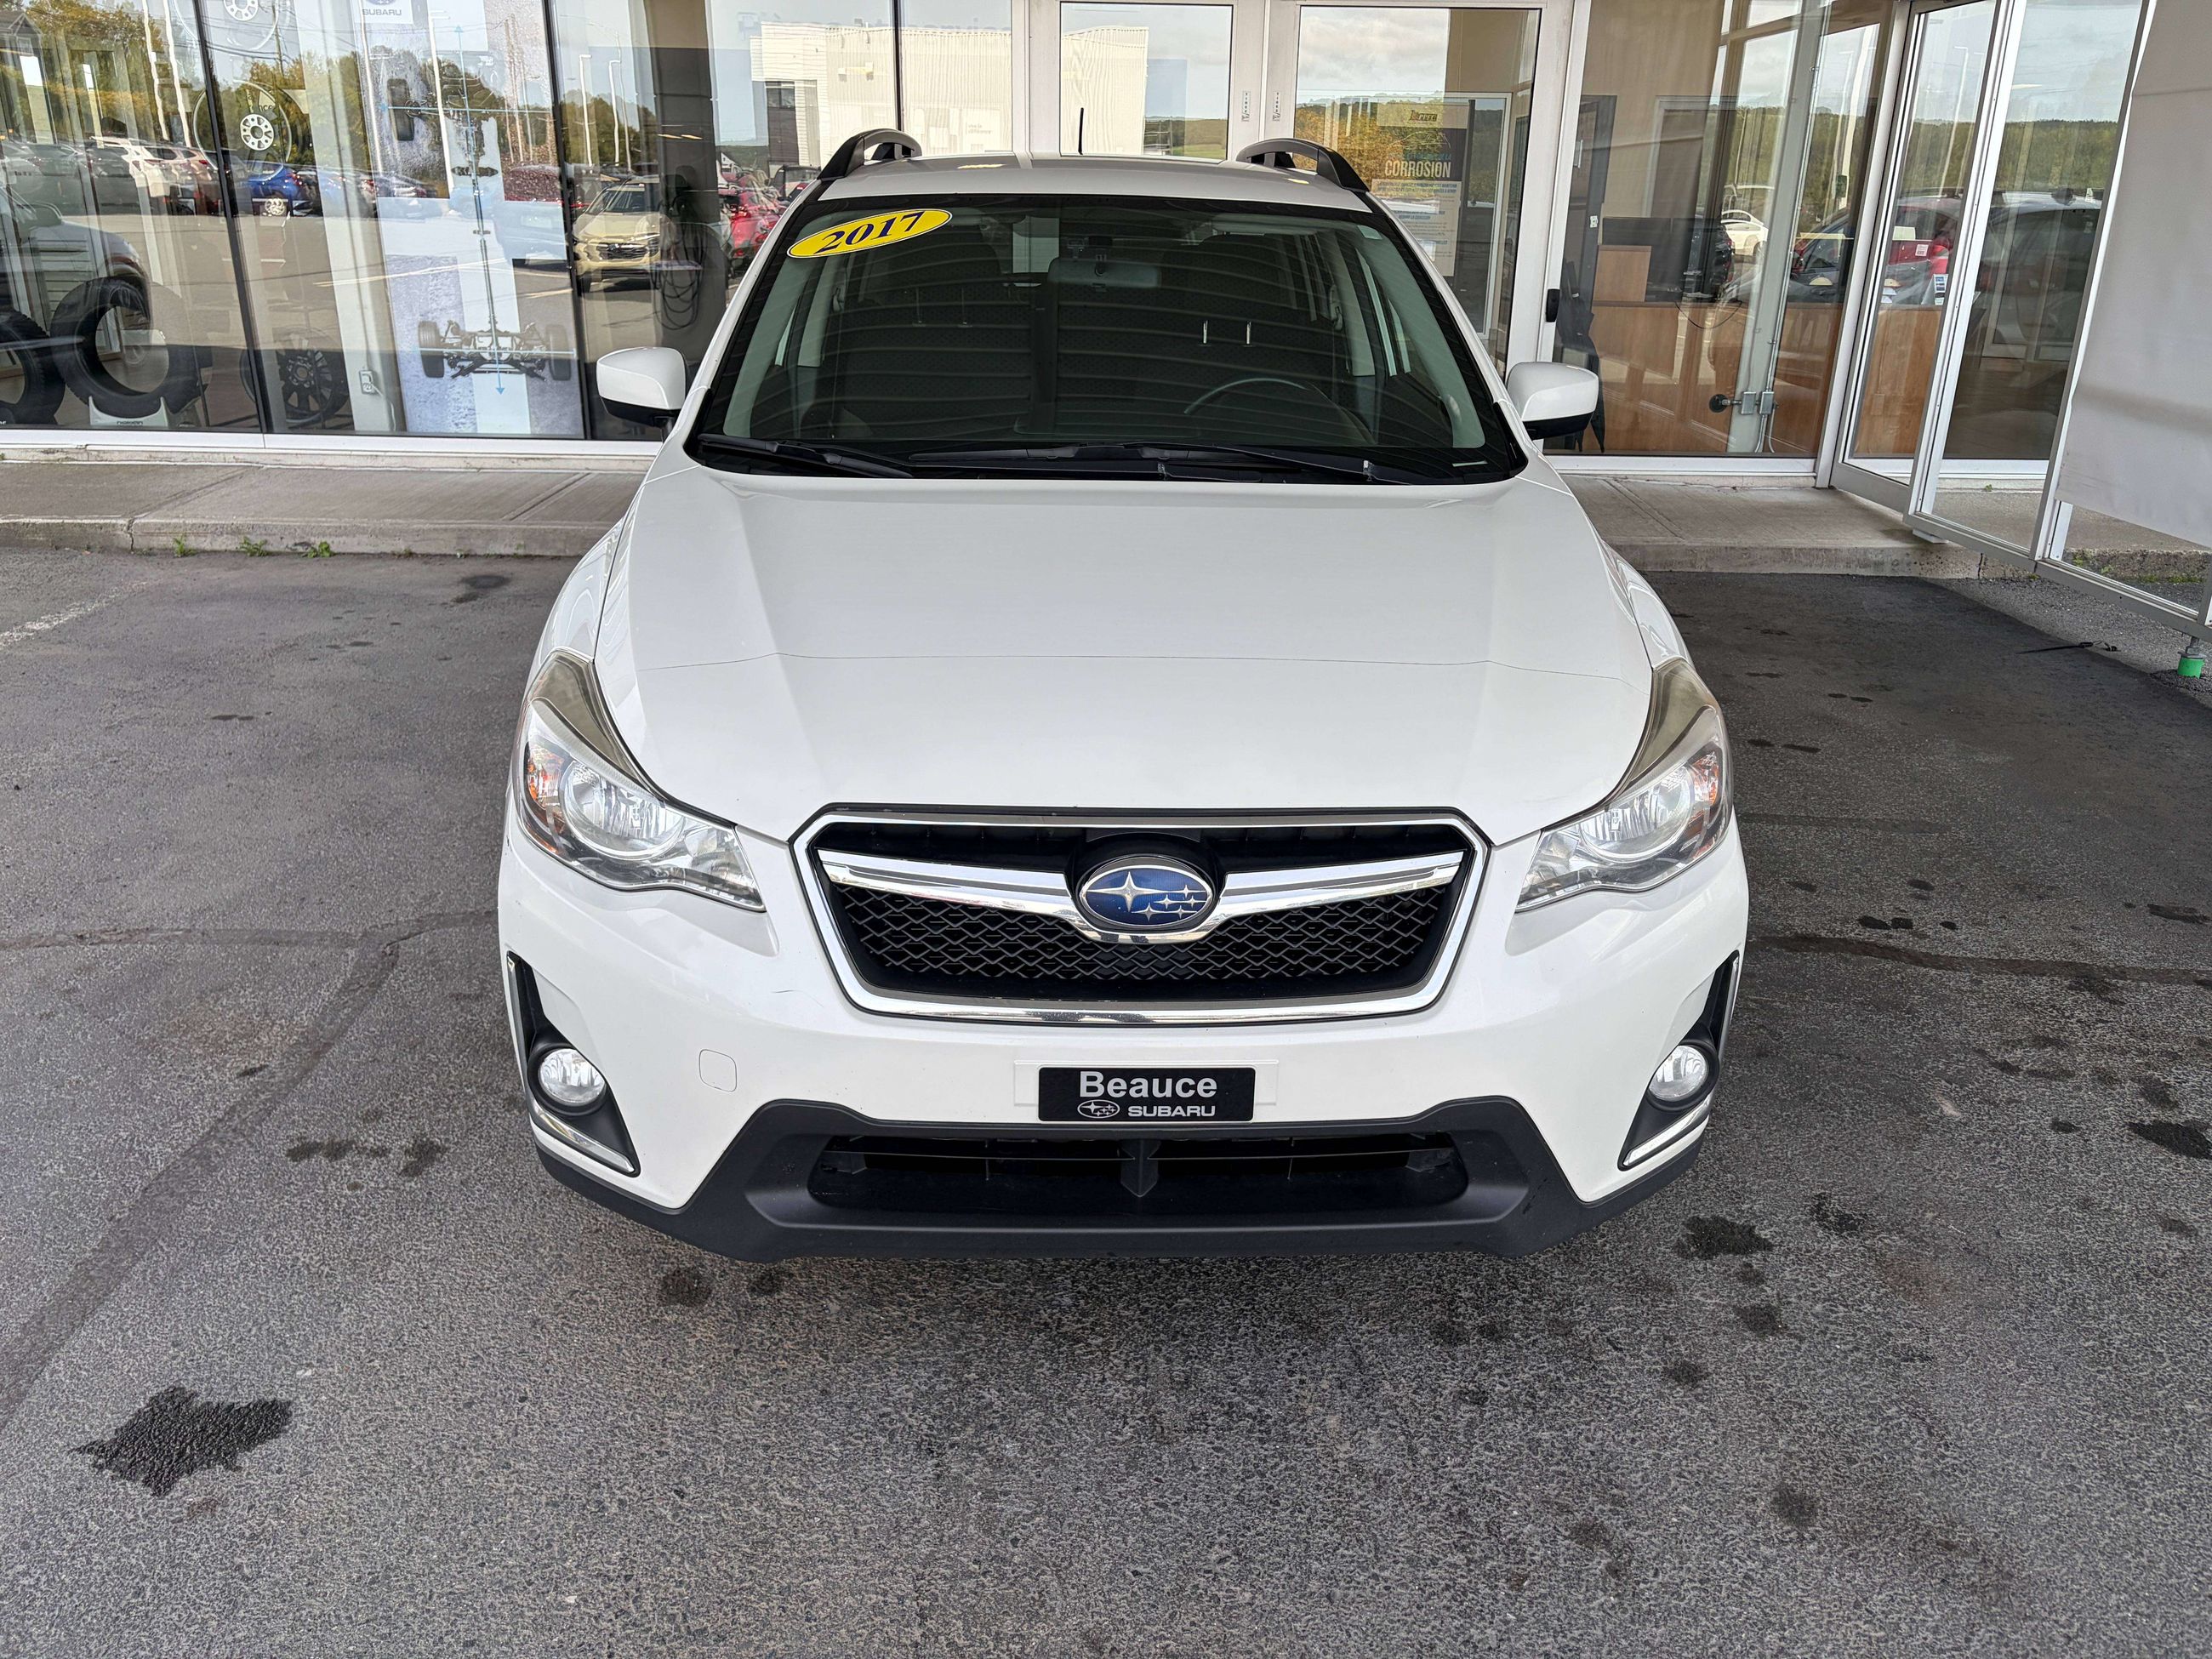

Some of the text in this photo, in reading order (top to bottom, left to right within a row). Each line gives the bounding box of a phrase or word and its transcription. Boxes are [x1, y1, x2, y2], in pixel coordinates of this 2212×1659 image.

[1384, 160, 1451, 178] CORROSION
[813, 211, 926, 255] 2017
[1080, 1070, 1217, 1098] Beauce
[1128, 1105, 1216, 1117] SUBARU
